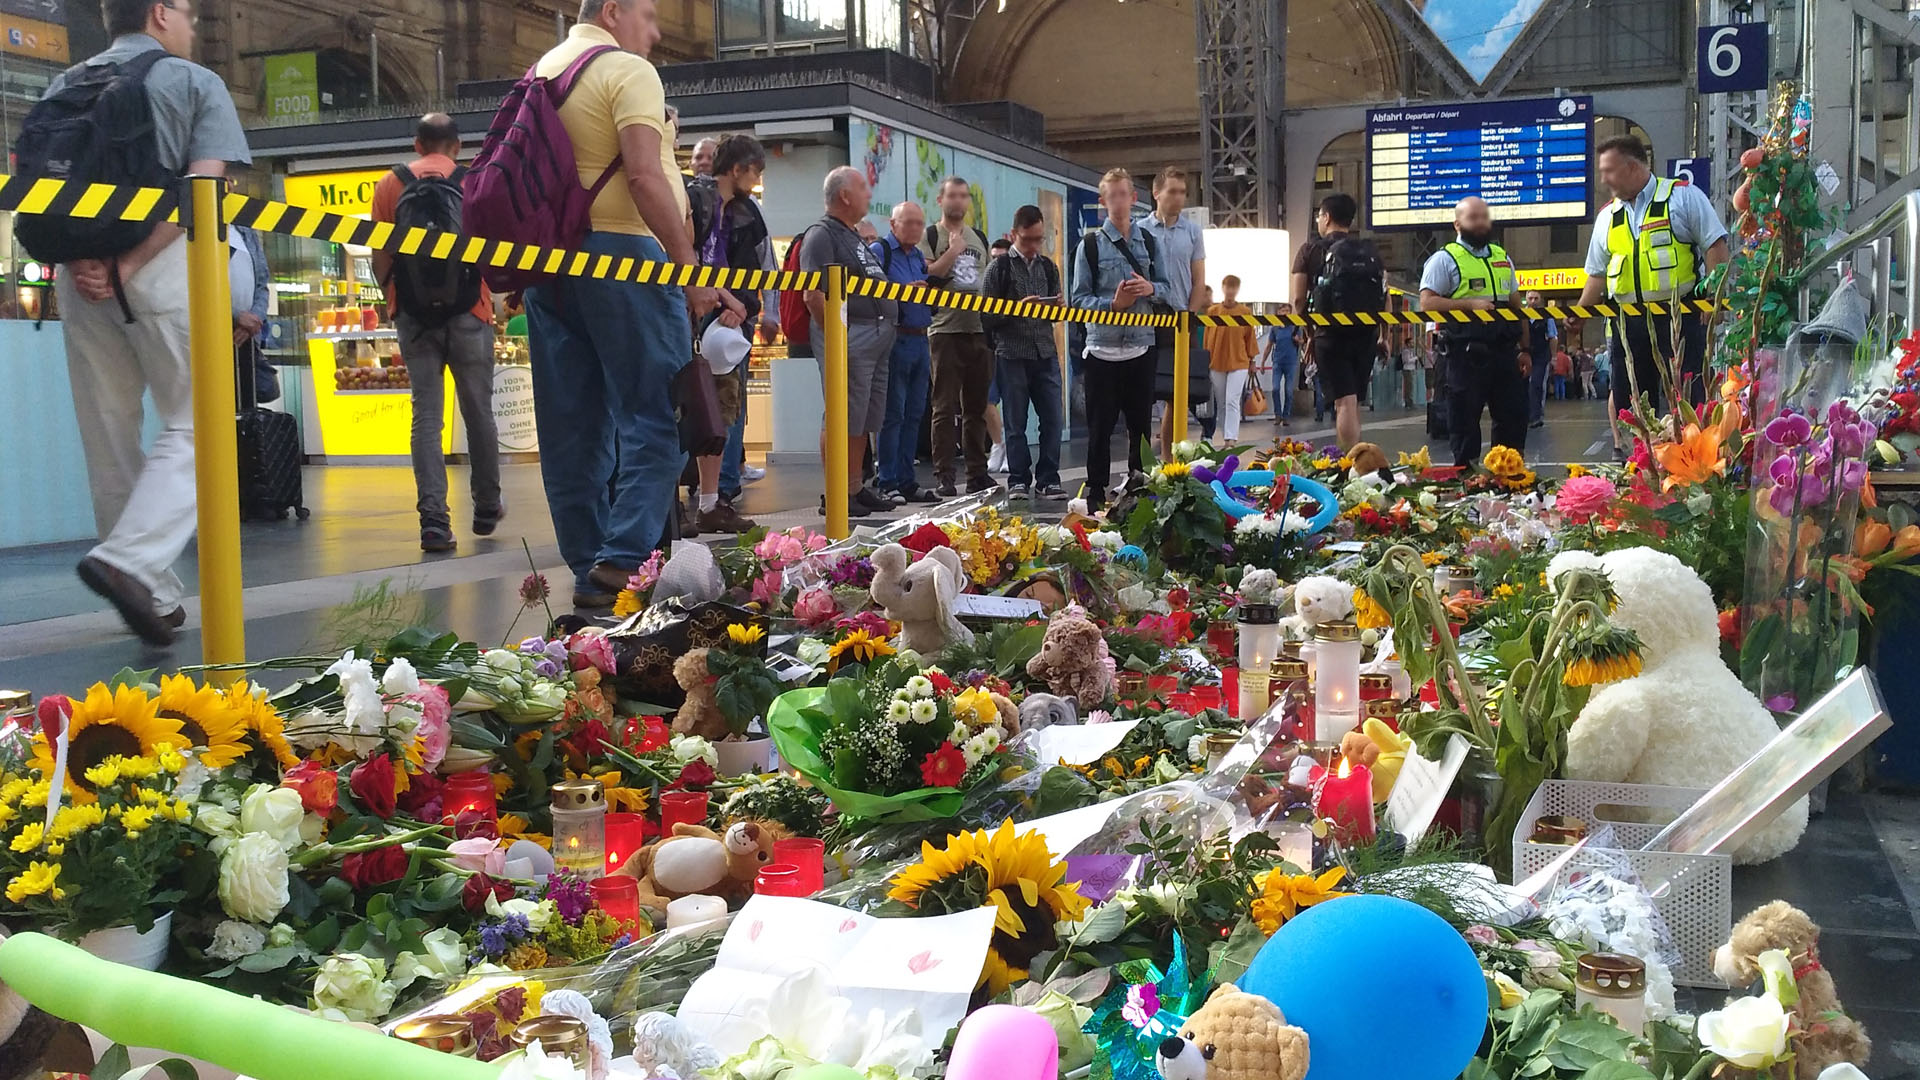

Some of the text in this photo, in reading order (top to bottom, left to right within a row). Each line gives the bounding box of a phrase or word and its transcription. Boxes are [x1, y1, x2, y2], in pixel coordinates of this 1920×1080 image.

[1707, 26, 1742, 77] 6
[274, 95, 311, 113] FOOD
[1372, 112, 1403, 122] Abfahrt
[1405, 112, 1435, 120] Departure
[1674, 159, 1695, 186] 5
[319, 181, 379, 207] Mr. C
[1519, 272, 1577, 287] ker Eifler
[503, 377, 526, 386] 100%
[509, 420, 533, 429] OHNE
